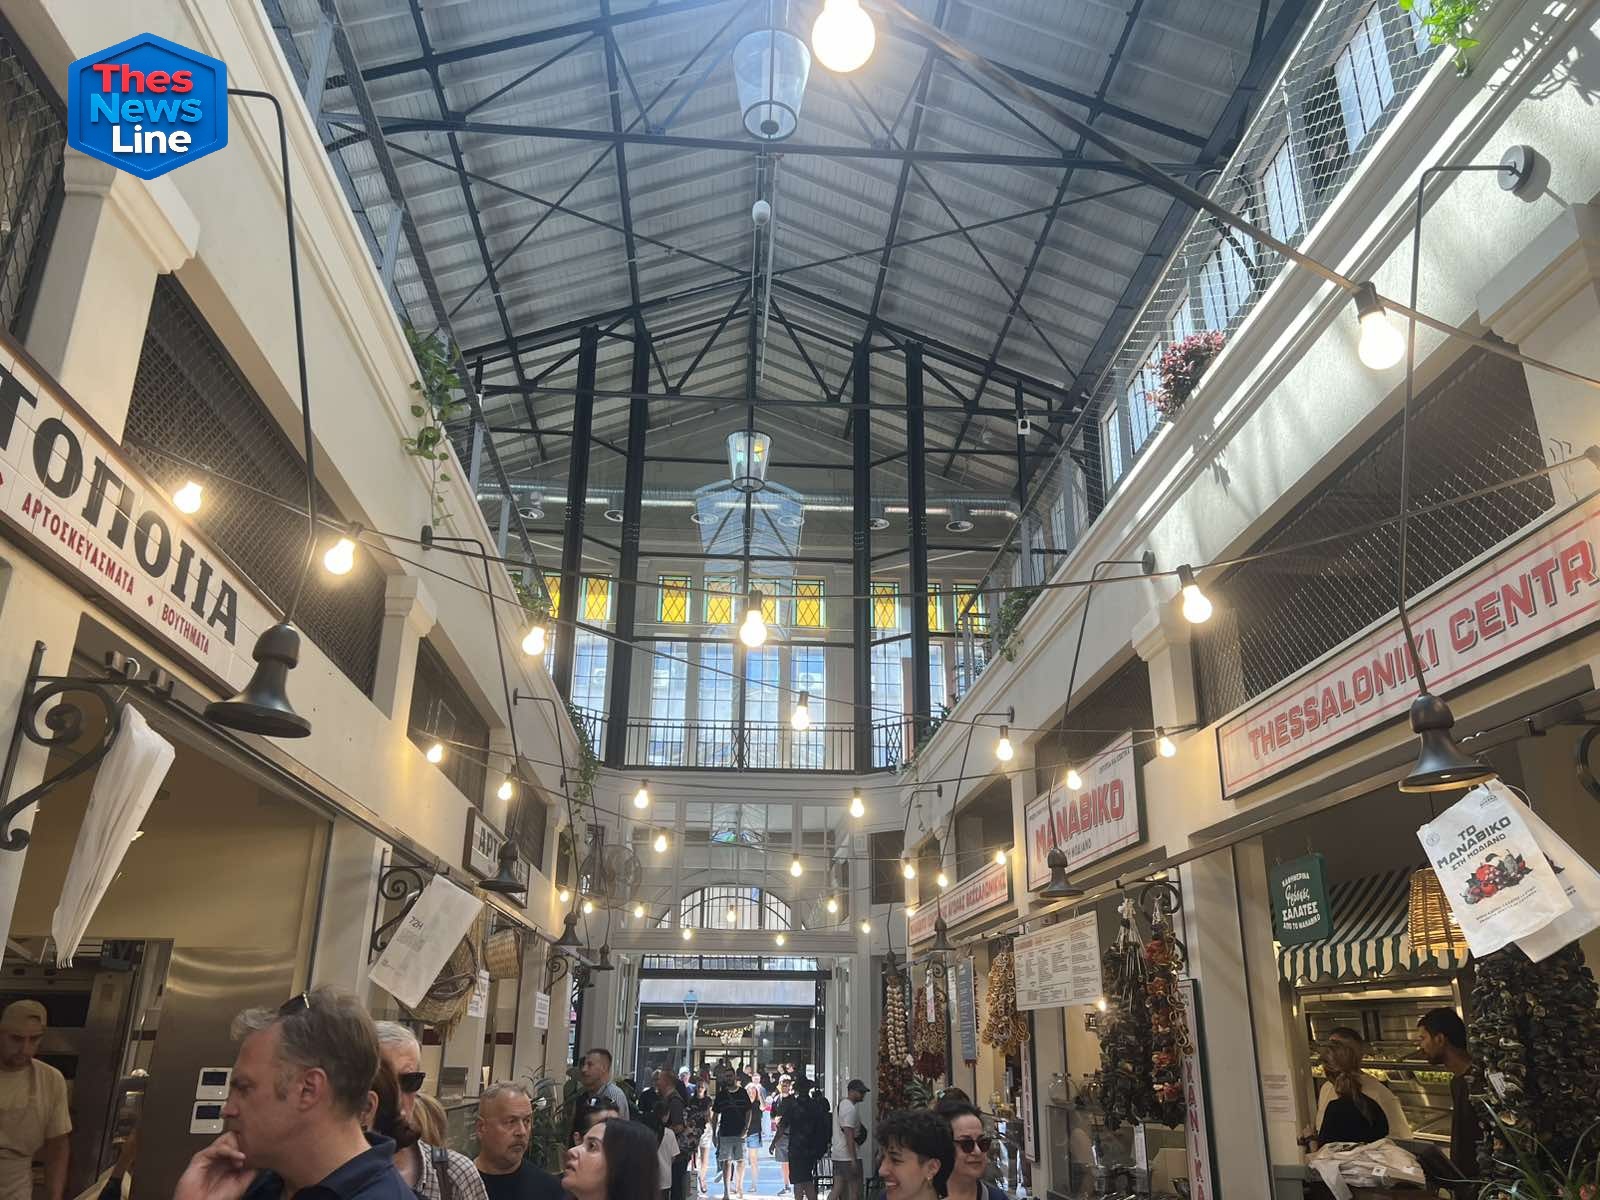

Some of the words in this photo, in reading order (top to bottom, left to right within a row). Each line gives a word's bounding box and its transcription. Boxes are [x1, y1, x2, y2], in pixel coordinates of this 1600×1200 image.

[22, 492, 134, 595] ΑΡΤΟΣΚΕΥΑΣΜΑΤΑ
[162, 603, 209, 655] ΒΟΥΤΗΜΑΤΑ
[1248, 628, 1439, 760] THESSALONIKI
[1436, 816, 1512, 869] ΜΑΝΑΒΙΚΟ
[1452, 858, 1467, 871] ΣΤΗ
[1467, 833, 1507, 863] ΜΟΔΙΑΝΟ
[1458, 824, 1477, 841] ΤΟ
[1282, 902, 1318, 921] ΣΑΛΑΤΕΣ
